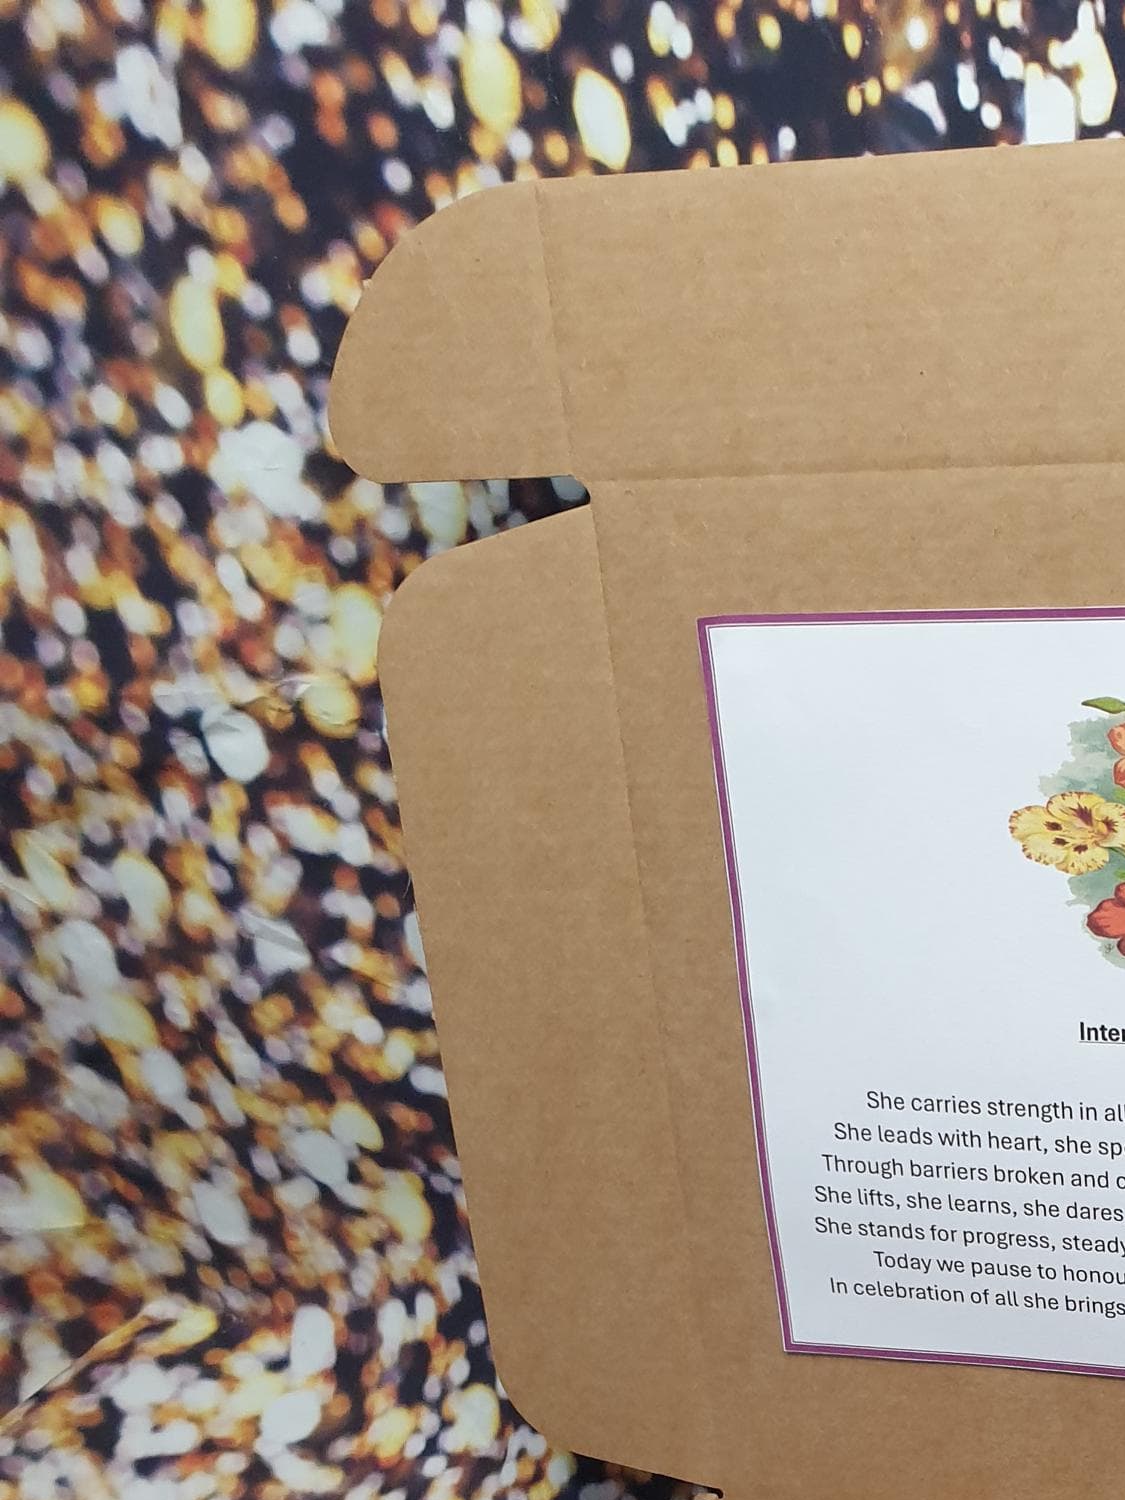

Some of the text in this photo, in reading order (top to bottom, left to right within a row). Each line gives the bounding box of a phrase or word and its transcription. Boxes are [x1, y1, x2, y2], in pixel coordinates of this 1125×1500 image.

[866, 1090, 905, 1111] She
[910, 1095, 982, 1115] carries
[987, 1099, 1074, 1124] strength
[1079, 1101, 1098, 1122] in
[833, 1121, 873, 1142] She
[877, 1124, 934, 1146] leads
[937, 1128, 982, 1149] with
[987, 1130, 1048, 1156] heart,
[1054, 1135, 1092, 1155] she
[820, 1153, 904, 1180] Through
[909, 1159, 989, 1182] barriers
[993, 1164, 1065, 1187] broken
[1070, 1170, 1110, 1189] and
[814, 1185, 853, 1205] She
[857, 1187, 901, 1211] lifts,
[906, 1191, 943, 1211] she
[947, 1193, 1018, 1219] learns,
[1023, 1198, 1060, 1218] she
[814, 1216, 853, 1236] She
[857, 1221, 926, 1241] stands
[929, 1224, 958, 1243] for
[962, 1230, 1056, 1253] progress,
[872, 1250, 932, 1275] Today
[935, 1258, 966, 1274] we
[970, 1261, 1032, 1279] pause
[1036, 1263, 1057, 1281] to
[829, 1276, 849, 1295] In
[853, 1280, 965, 1304] celebration
[970, 1288, 990, 1305] of
[995, 1289, 1020, 1308] all
[1023, 1292, 1060, 1311] she
